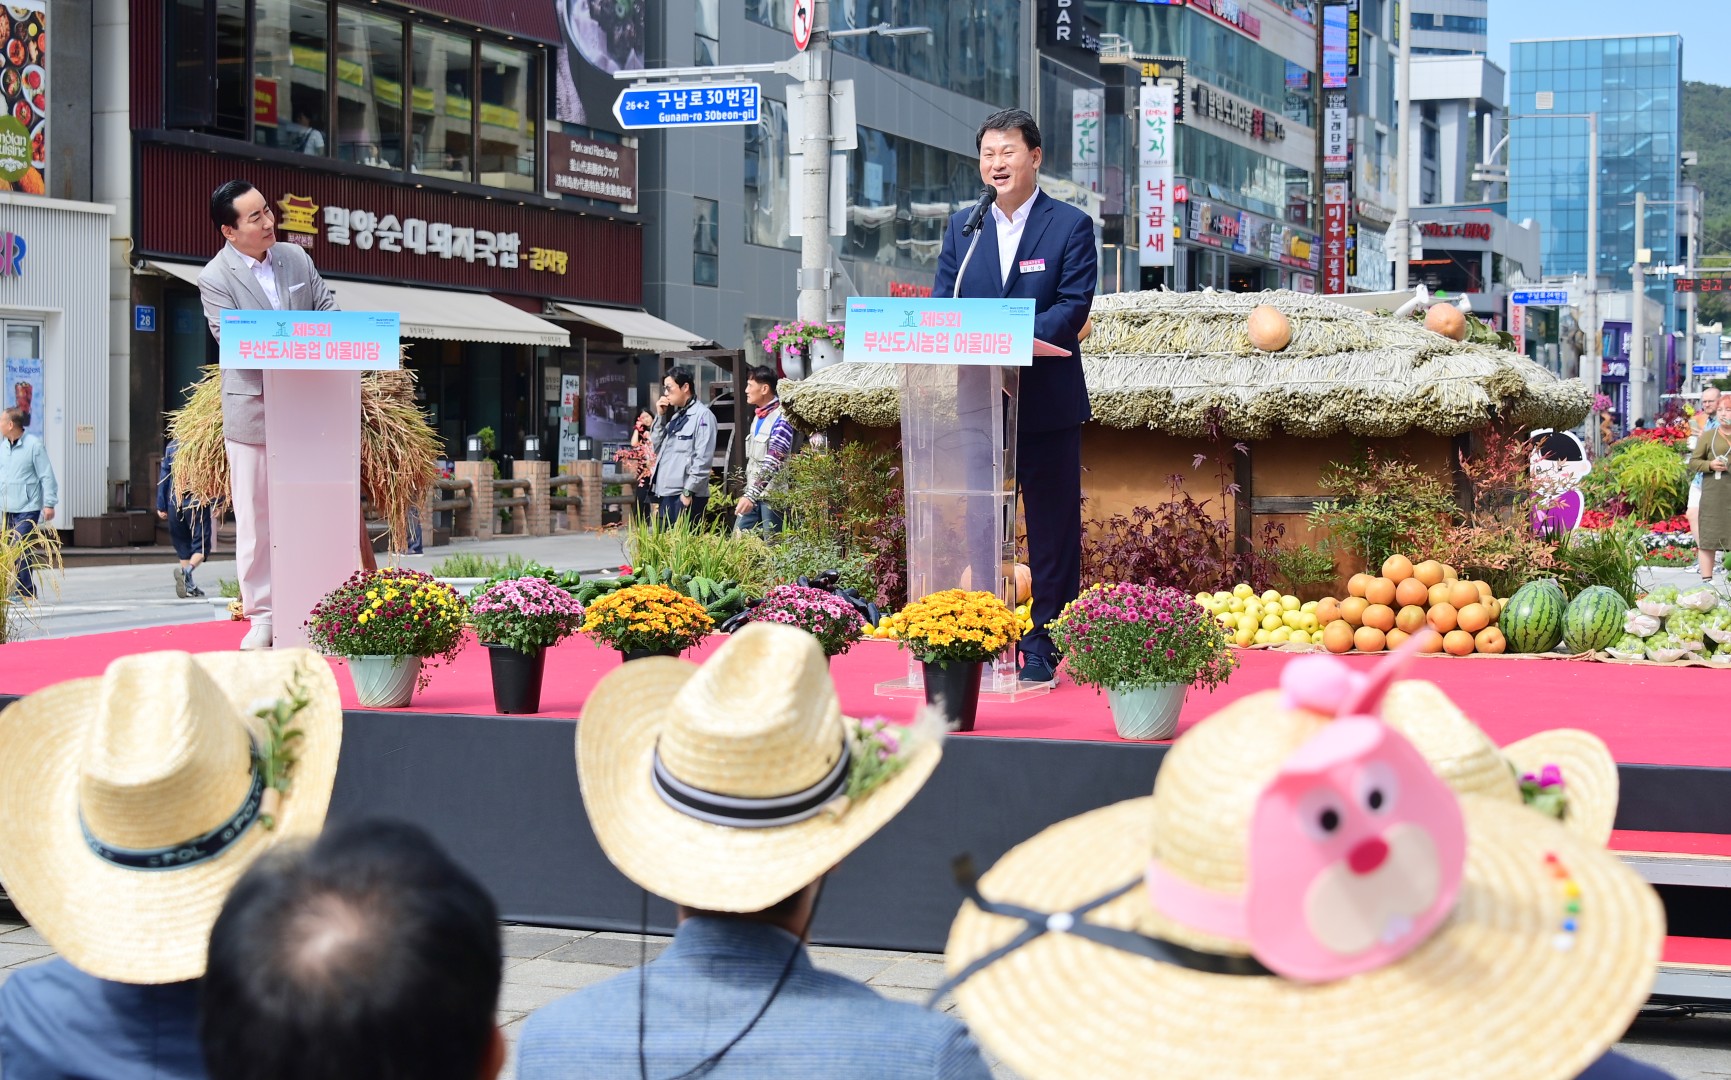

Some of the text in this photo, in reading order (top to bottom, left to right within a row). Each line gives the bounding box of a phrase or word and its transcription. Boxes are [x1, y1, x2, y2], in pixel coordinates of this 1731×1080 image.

[658, 109, 755, 123] Gunam-ro 30beon-gil
[1145, 179, 1166, 252] 낙곱새
[1463, 222, 1492, 241] BBQ
[140, 314, 151, 326] 28
[920, 310, 962, 328] 제5회
[292, 321, 332, 337] 제5회
[239, 340, 381, 361] 부산도시농업 어울마당
[863, 331, 1013, 355] 부산도시농업 어울마당
